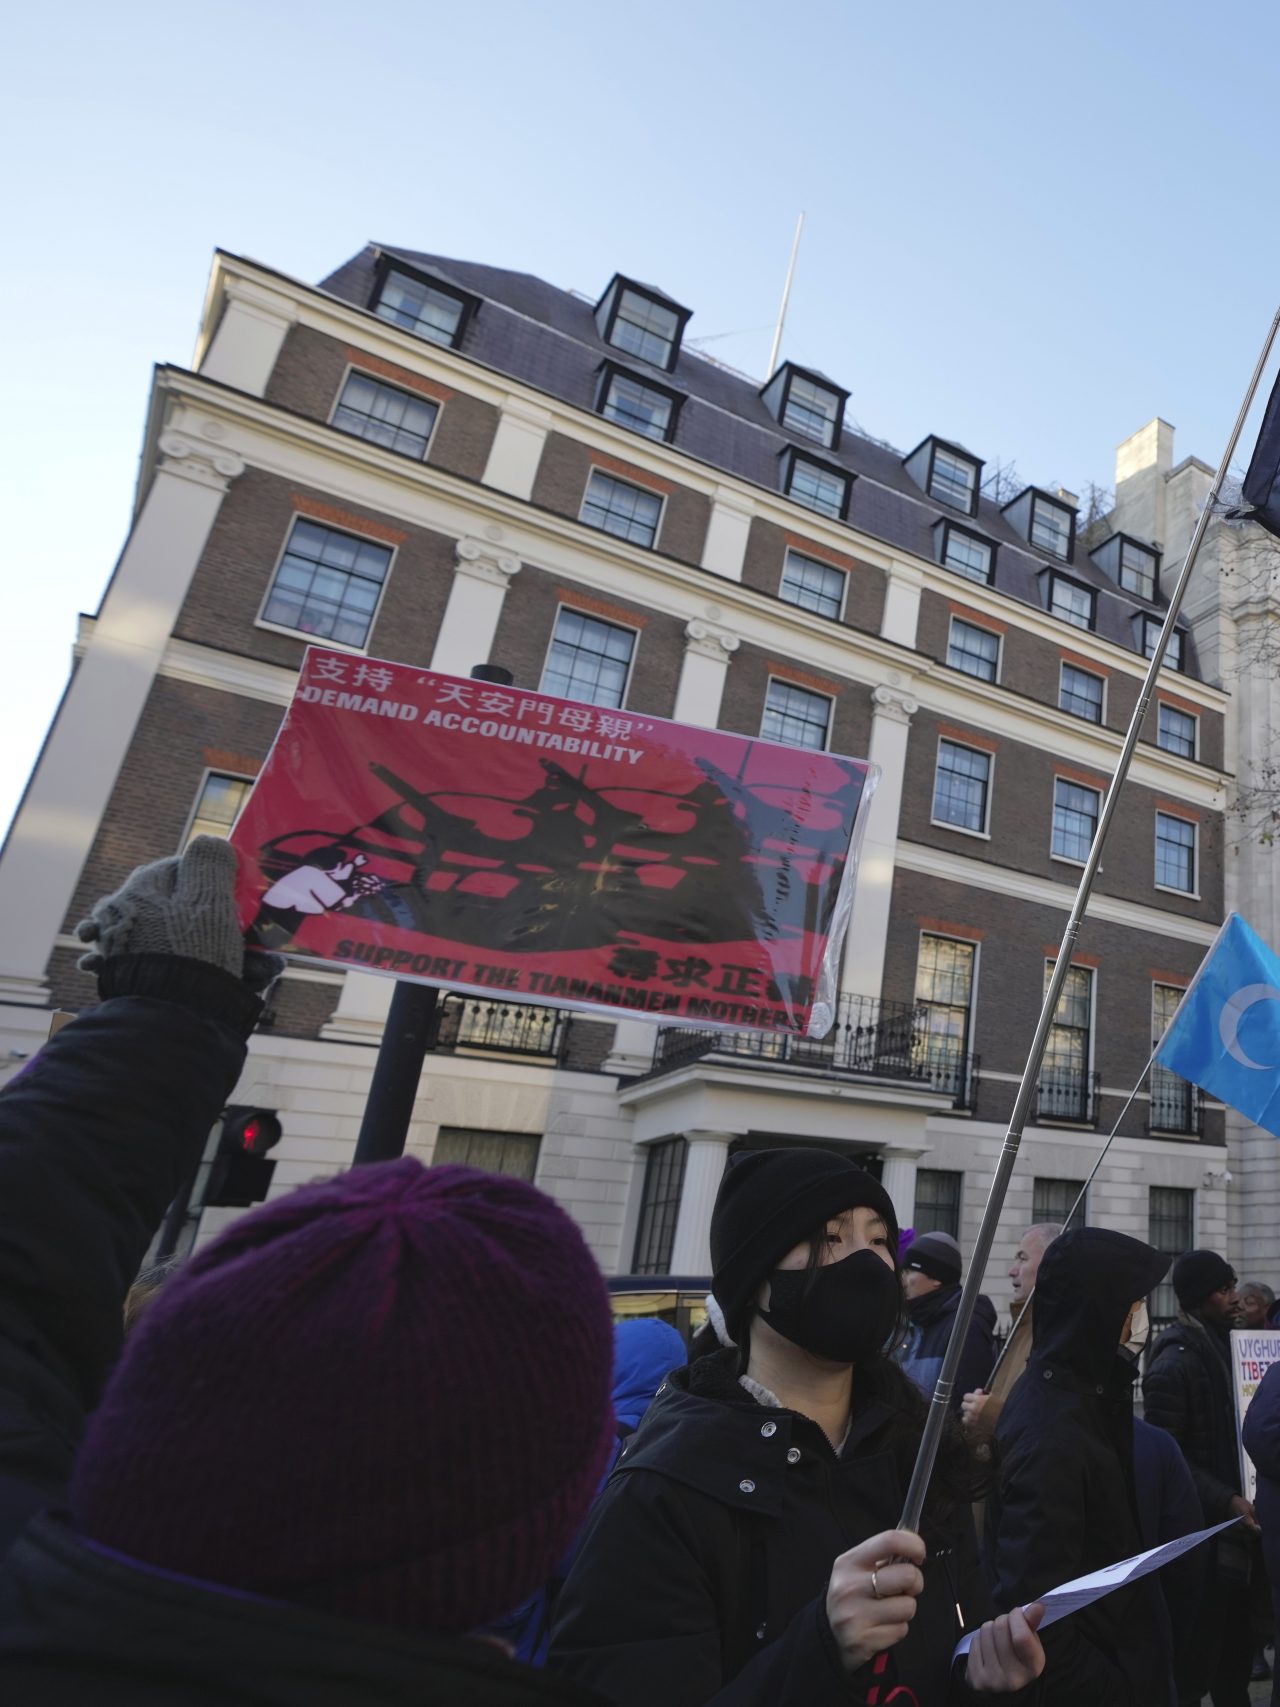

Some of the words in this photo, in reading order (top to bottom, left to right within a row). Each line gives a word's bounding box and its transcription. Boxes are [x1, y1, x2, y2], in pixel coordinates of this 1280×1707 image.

[310, 657, 393, 693] 支持
[302, 686, 418, 721] DEMAND
[423, 709, 645, 765] ACCOUNTABILITY
[333, 939, 467, 979] SUPPORT
[473, 963, 521, 989] THE
[529, 972, 682, 1012] TIANANMEN
[686, 996, 805, 1033] MOTHERS
